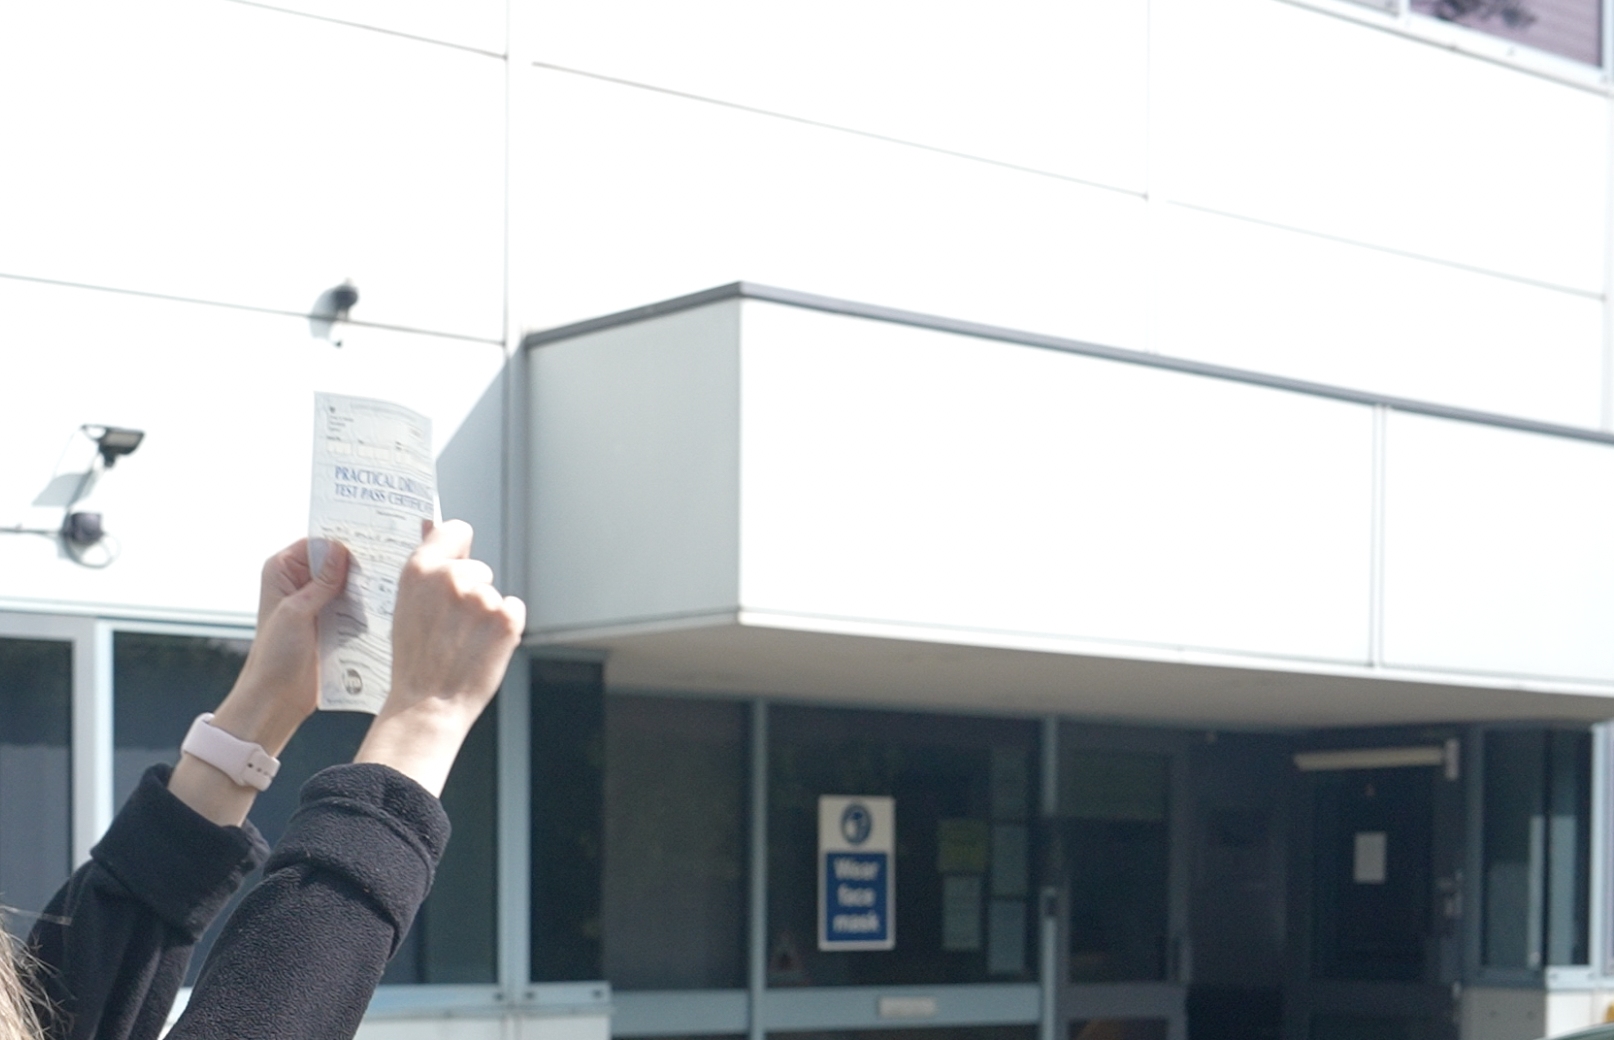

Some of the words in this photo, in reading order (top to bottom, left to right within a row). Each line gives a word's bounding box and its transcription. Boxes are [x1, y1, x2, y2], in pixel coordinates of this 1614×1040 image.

[334, 465, 396, 490] PRACTICAL
[334, 482, 358, 499] TEST
[360, 486, 386, 503] PASS
